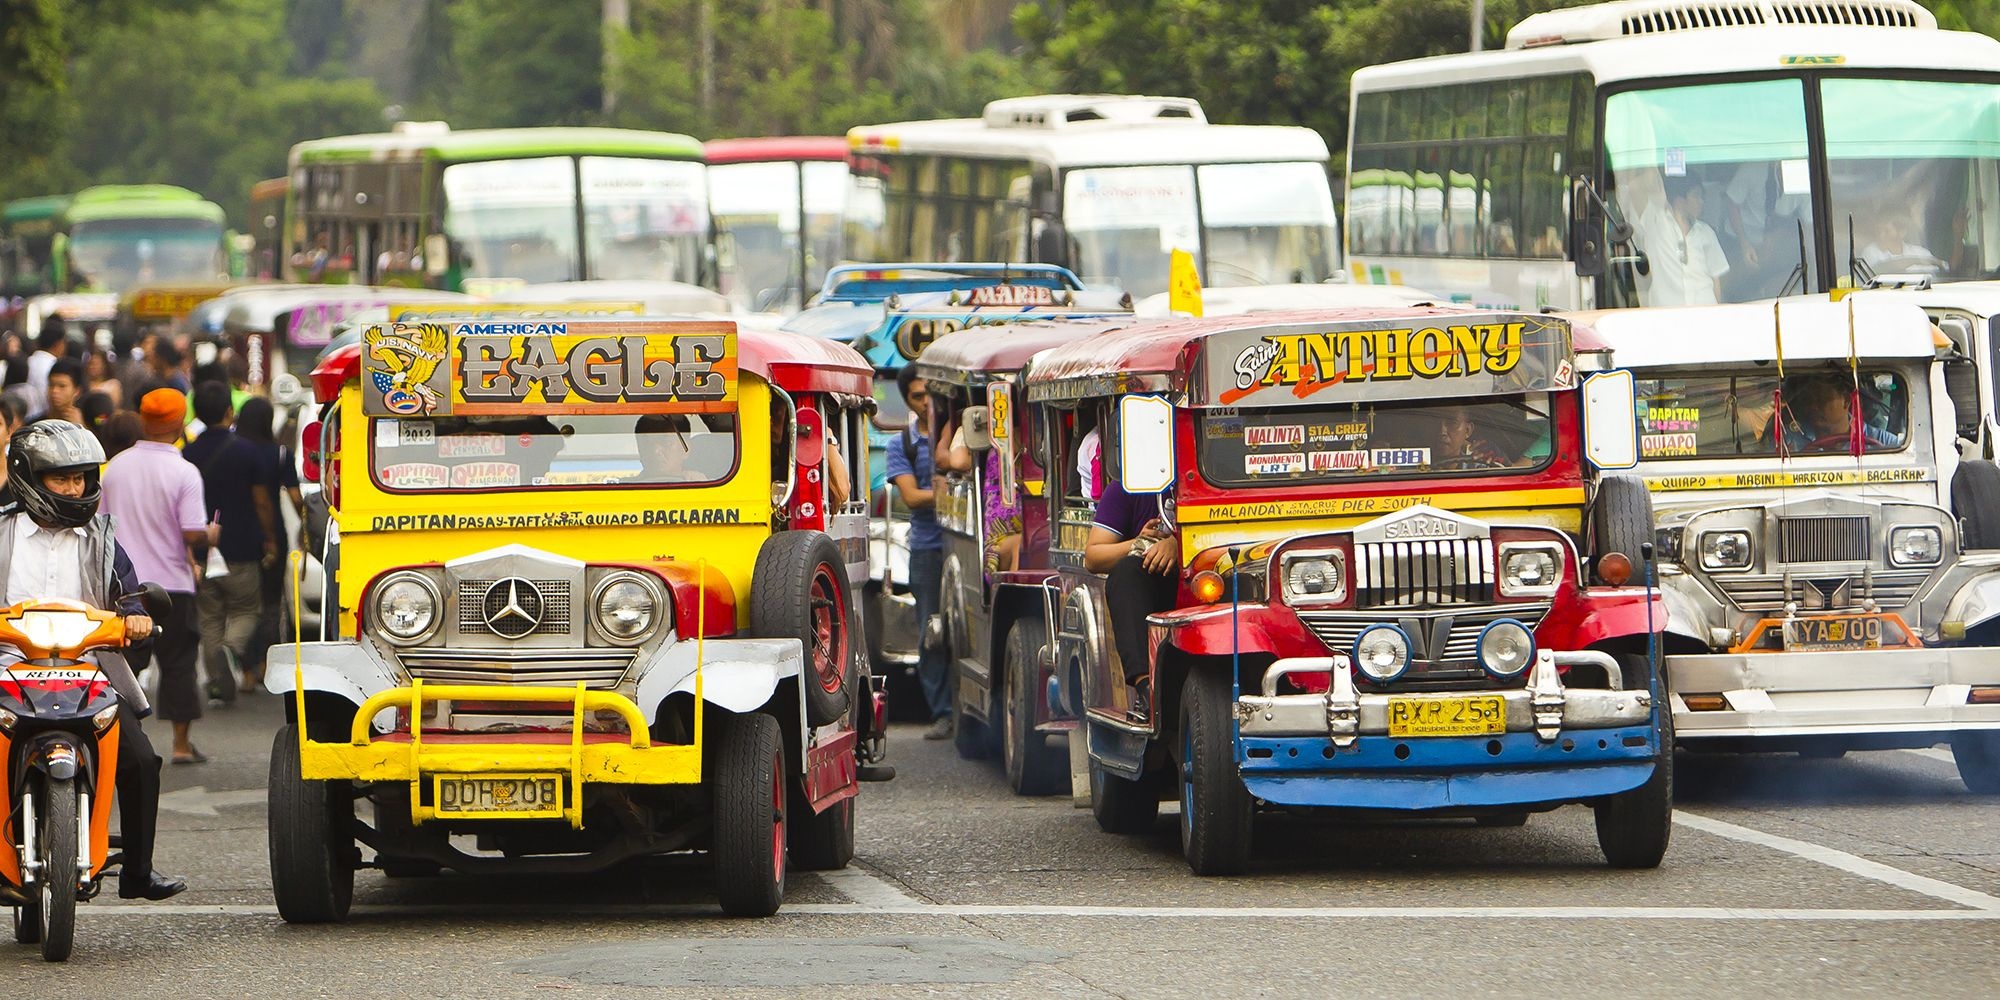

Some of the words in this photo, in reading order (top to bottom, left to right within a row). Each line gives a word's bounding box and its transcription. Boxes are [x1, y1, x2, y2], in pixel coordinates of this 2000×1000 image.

[456, 323, 567, 335] AMERICAN
[402, 341, 434, 361] NAVY
[1234, 337, 1279, 390] Saint
[1260, 322, 1526, 386] ANTHONY
[458, 336, 727, 402] EAGLE
[1649, 407, 1699, 422] DAPITAN
[1656, 421, 1691, 430] UST
[404, 429, 431, 441] 2012
[1248, 427, 1302, 443] MALINTA
[1309, 434, 1338, 443] AVENIDA
[1644, 435, 1694, 451] QUIAPO
[1249, 454, 1302, 465] MONUMENTO
[1312, 451, 1366, 469] MALANDAY
[1377, 450, 1423, 465] BBB
[387, 465, 446, 485] DAPITAN
[453, 464, 517, 486] QUIAPO
[1260, 463, 1289, 473] LRT
[1661, 477, 1706, 488] QUIAPO
[1736, 474, 1775, 486] MABINI
[1793, 472, 1843, 484] HARRIZON
[1867, 469, 1925, 481] BACLARAN
[1209, 504, 1282, 519] MALANDAY
[1342, 499, 1375, 511] PIER
[1382, 496, 1431, 509] SOUTH
[1286, 508, 1336, 516] MONUMENTO
[372, 514, 456, 531] DAPITAN
[585, 513, 638, 525] QUIAPO
[642, 508, 740, 525] BACLARAN
[541, 518, 585, 527] CENTRAL
[1385, 518, 1459, 539] SARAO
[1784, 620, 1829, 642] NYA
[1834, 619, 1880, 641] 700
[26, 671, 82, 679] REPSOL
[1450, 699, 1500, 723] 253
